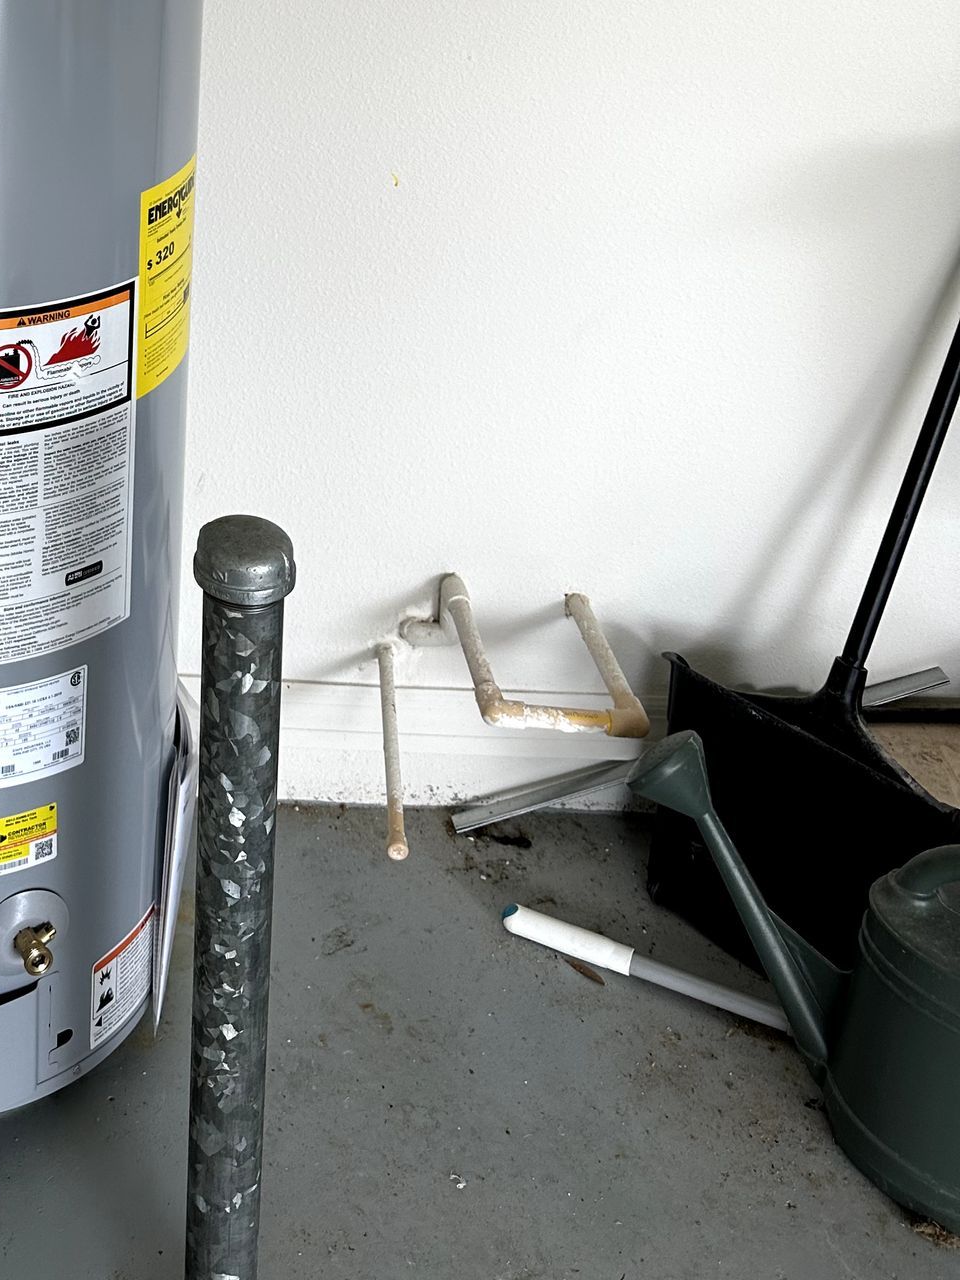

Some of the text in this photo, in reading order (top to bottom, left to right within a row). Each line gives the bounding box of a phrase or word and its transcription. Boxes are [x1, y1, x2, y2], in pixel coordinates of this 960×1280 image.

[156, 241, 174, 265] 320
[28, 310, 70, 325] WARNING
[31, 386, 57, 395] EXPLOSION
[8, 822, 46, 836] CONTRACTOR
